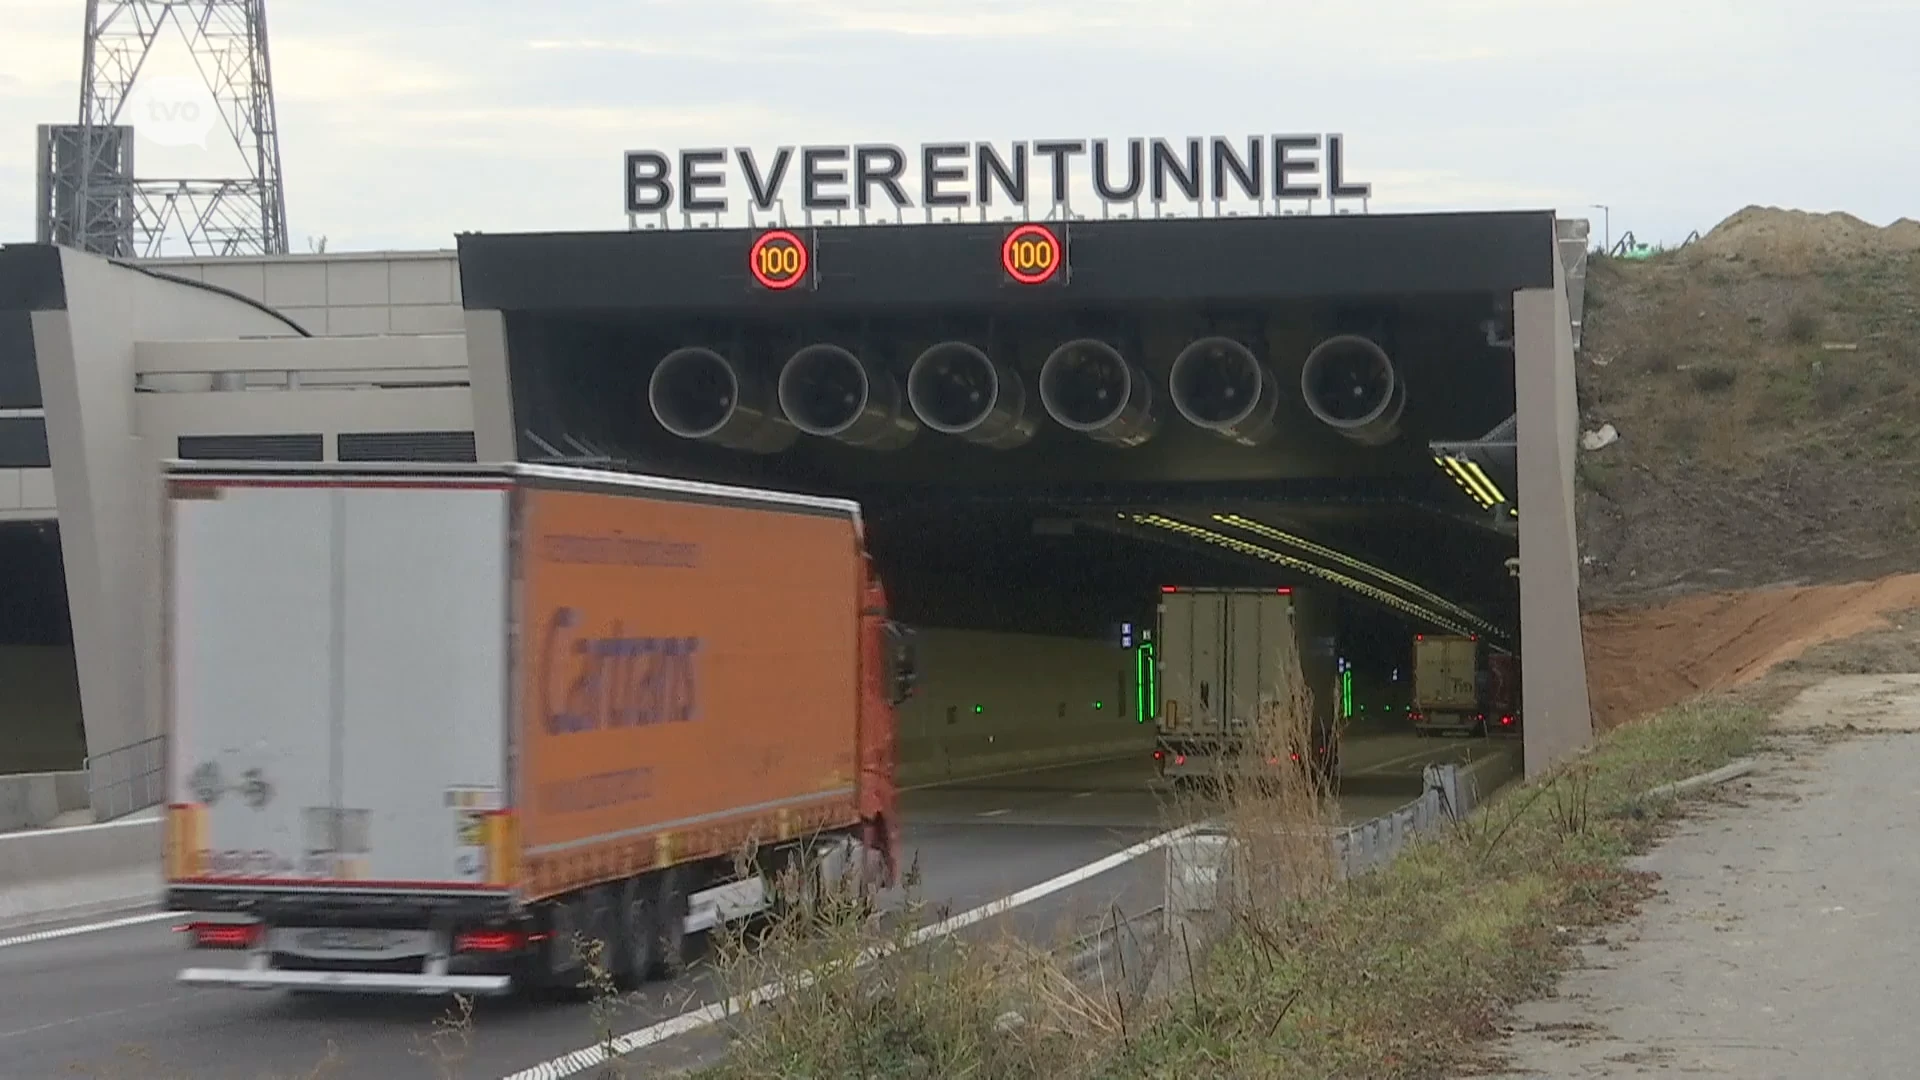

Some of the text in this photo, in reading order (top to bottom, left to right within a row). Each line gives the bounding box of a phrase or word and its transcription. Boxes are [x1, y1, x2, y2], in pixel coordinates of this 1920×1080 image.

[624, 133, 1371, 214] BEVERENTUNNEL
[759, 246, 798, 274] 100
[1011, 241, 1051, 269] 100
